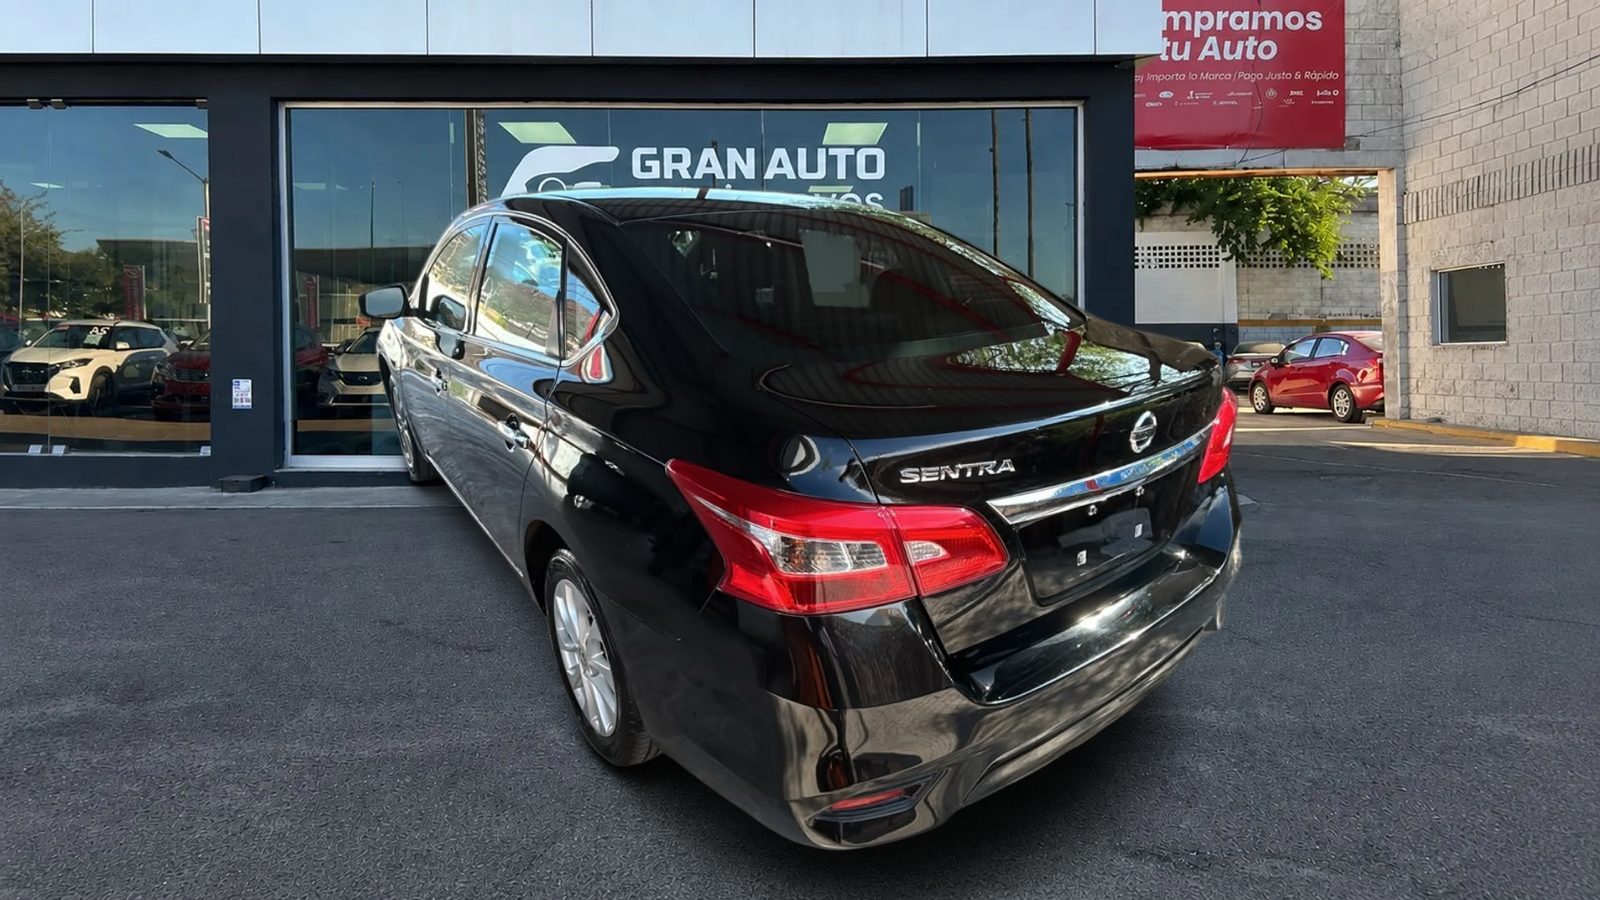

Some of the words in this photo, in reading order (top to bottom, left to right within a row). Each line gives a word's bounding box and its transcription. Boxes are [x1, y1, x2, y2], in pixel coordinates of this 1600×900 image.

[1162, 10, 1323, 38] mpramos
[1160, 37, 1191, 61] tu
[1197, 36, 1278, 61] Auto
[1147, 73, 1186, 83] Importa
[1189, 72, 1198, 80] la
[1200, 72, 1232, 81] Marca
[1238, 71, 1263, 82] Pago
[1266, 71, 1293, 80] Justo
[1294, 71, 1302, 80] &
[632, 147, 755, 180] GRAN
[763, 147, 885, 180] AUTO
[900, 457, 1016, 484] SENTRA
